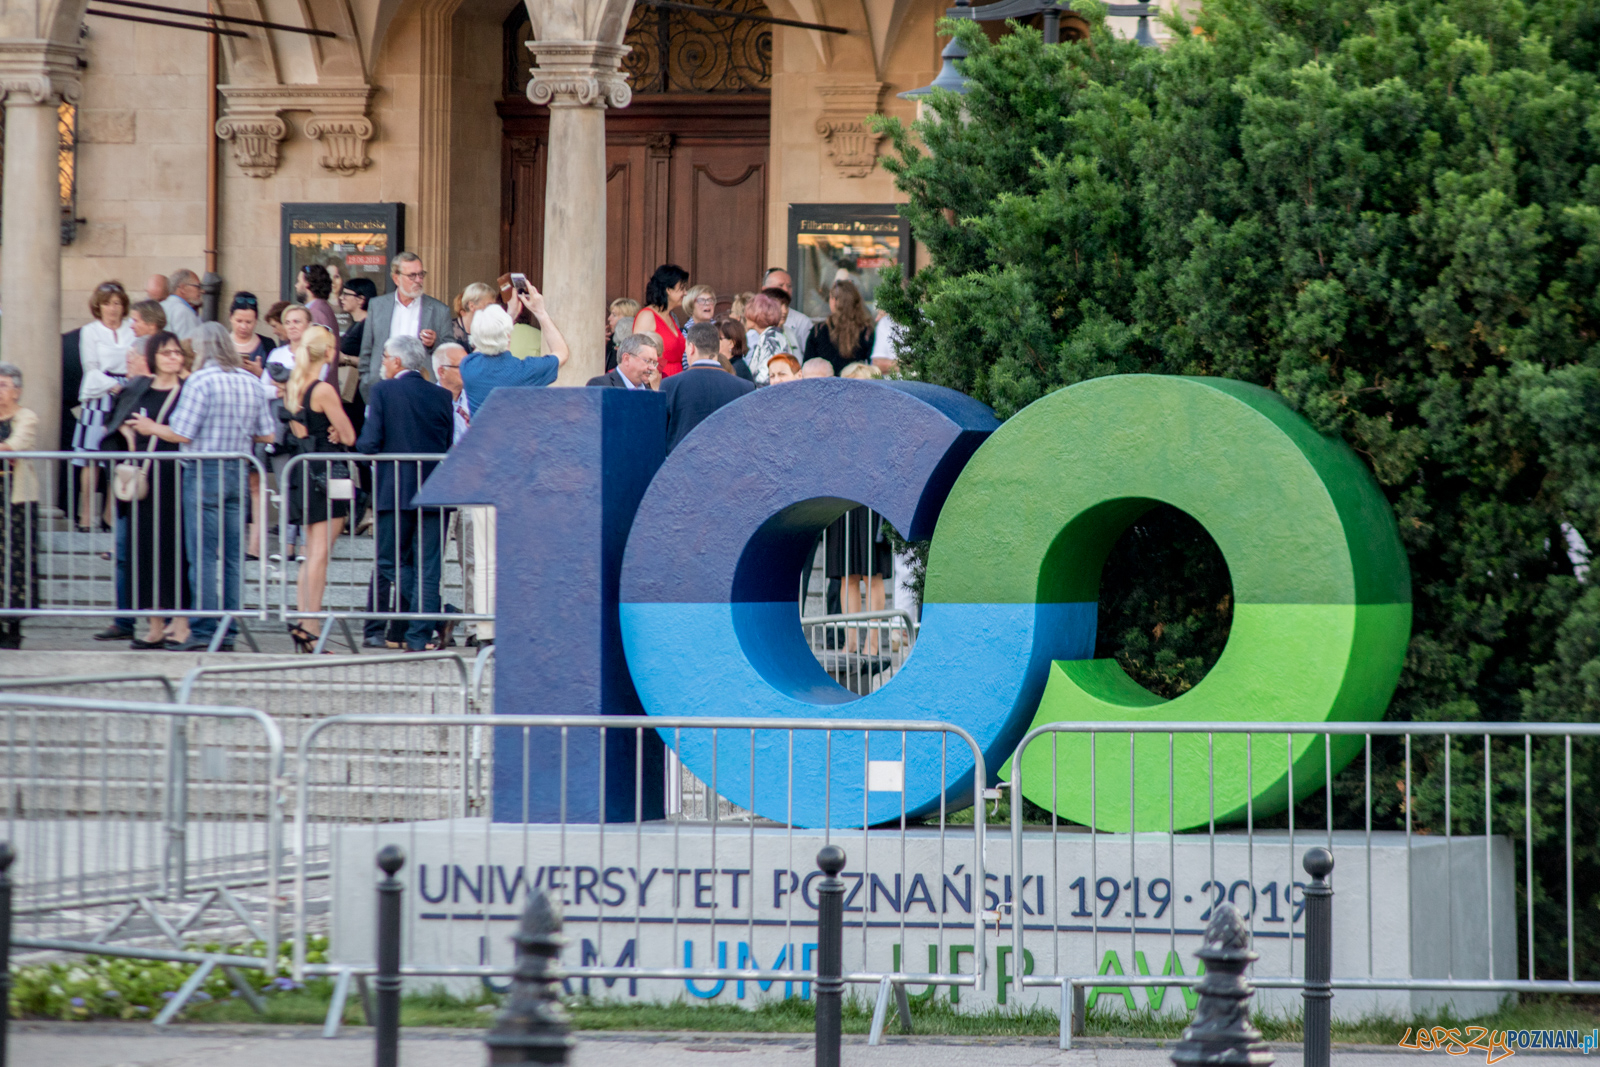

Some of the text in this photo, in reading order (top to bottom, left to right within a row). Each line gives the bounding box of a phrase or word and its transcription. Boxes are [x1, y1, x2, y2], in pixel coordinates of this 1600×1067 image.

[800, 219, 852, 231] Filharmonia
[418, 863, 750, 909] UNIWERSYTET
[773, 863, 1045, 916] POZNAŃSKI
